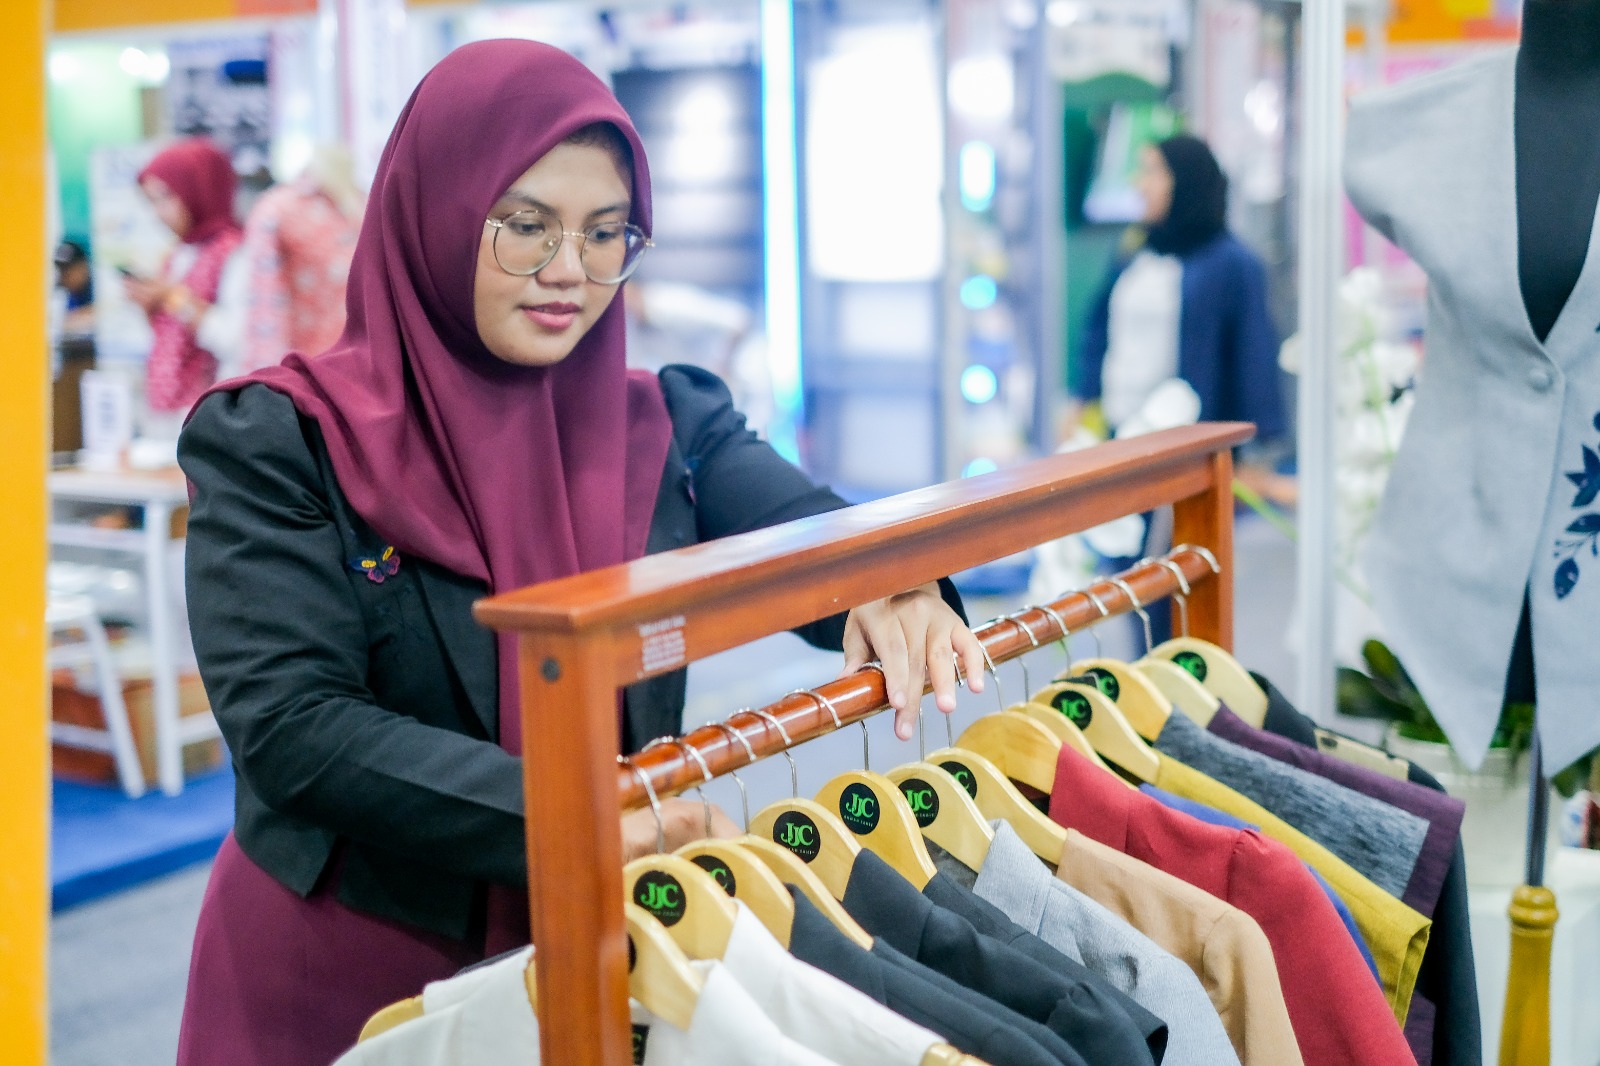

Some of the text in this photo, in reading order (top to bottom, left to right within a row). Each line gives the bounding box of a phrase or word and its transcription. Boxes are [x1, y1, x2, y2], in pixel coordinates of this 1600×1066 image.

[845, 793, 875, 818] JJC
[780, 822, 814, 847] JJC
[640, 882, 678, 909] JJC
